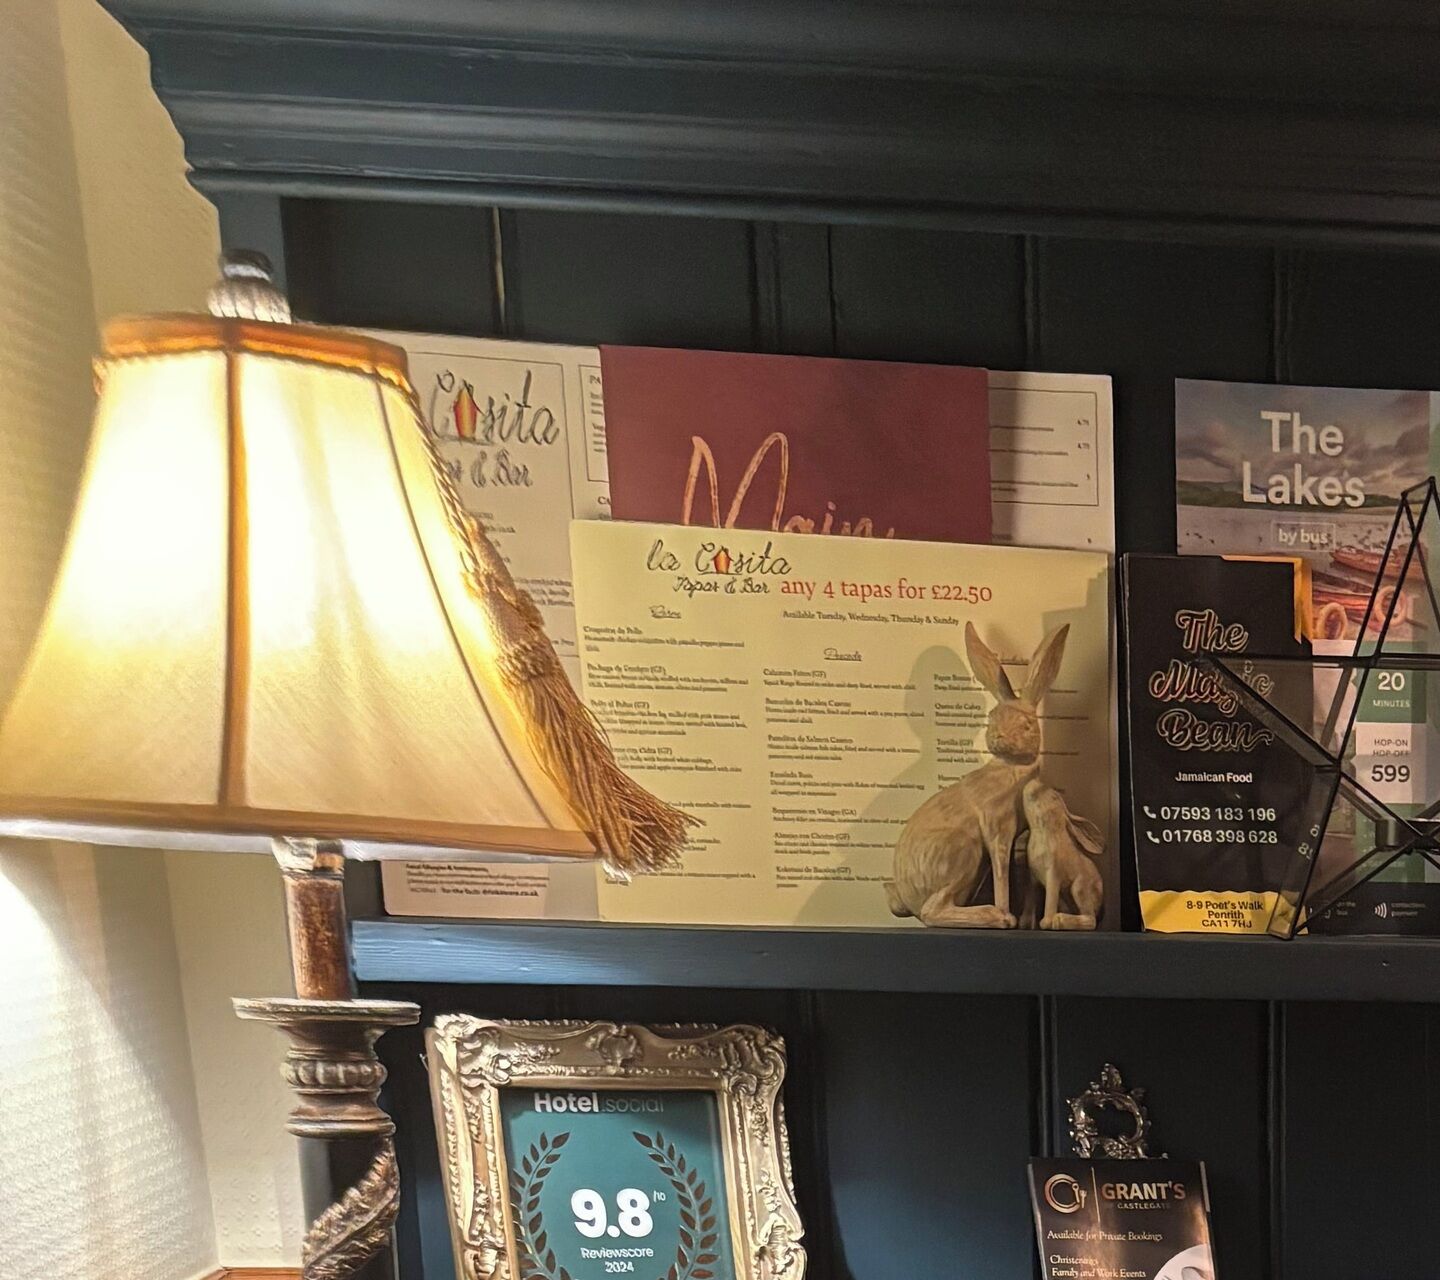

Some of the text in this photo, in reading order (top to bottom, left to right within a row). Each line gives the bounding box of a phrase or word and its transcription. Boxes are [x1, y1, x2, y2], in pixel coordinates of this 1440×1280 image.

[1260, 410, 1344, 456] The
[1242, 461, 1365, 508] Lakes
[1278, 527, 1328, 545] by bus
[781, 578, 993, 604] any 4 tapas for £22.50
[783, 611, 815, 620] Available
[1175, 609, 1249, 653] The
[1378, 672, 1405, 691] 20
[1372, 699, 1410, 708] MINUTES
[1156, 708, 1274, 751] Bean
[1374, 738, 1408, 747] HOP-ON
[1175, 771, 1253, 783] Jamaican Food
[1371, 764, 1411, 782] 599
[1160, 806, 1277, 822] 07593 183 196
[1162, 829, 1278, 844] 01768 398 628
[1186, 900, 1264, 910] 8-9 Walk
[1208, 911, 1245, 920] Penrith
[1101, 1180, 1186, 1200] GRANT'S
[570, 1188, 655, 1239] 9.8
[1047, 1230, 1163, 1243] Available for Private Bookings
[581, 1247, 655, 1260] Reviewscore
[1050, 1254, 1098, 1266] Christenings
[604, 1260, 635, 1274] 2024
[1052, 1267, 1147, 1279] Family and Work Events
